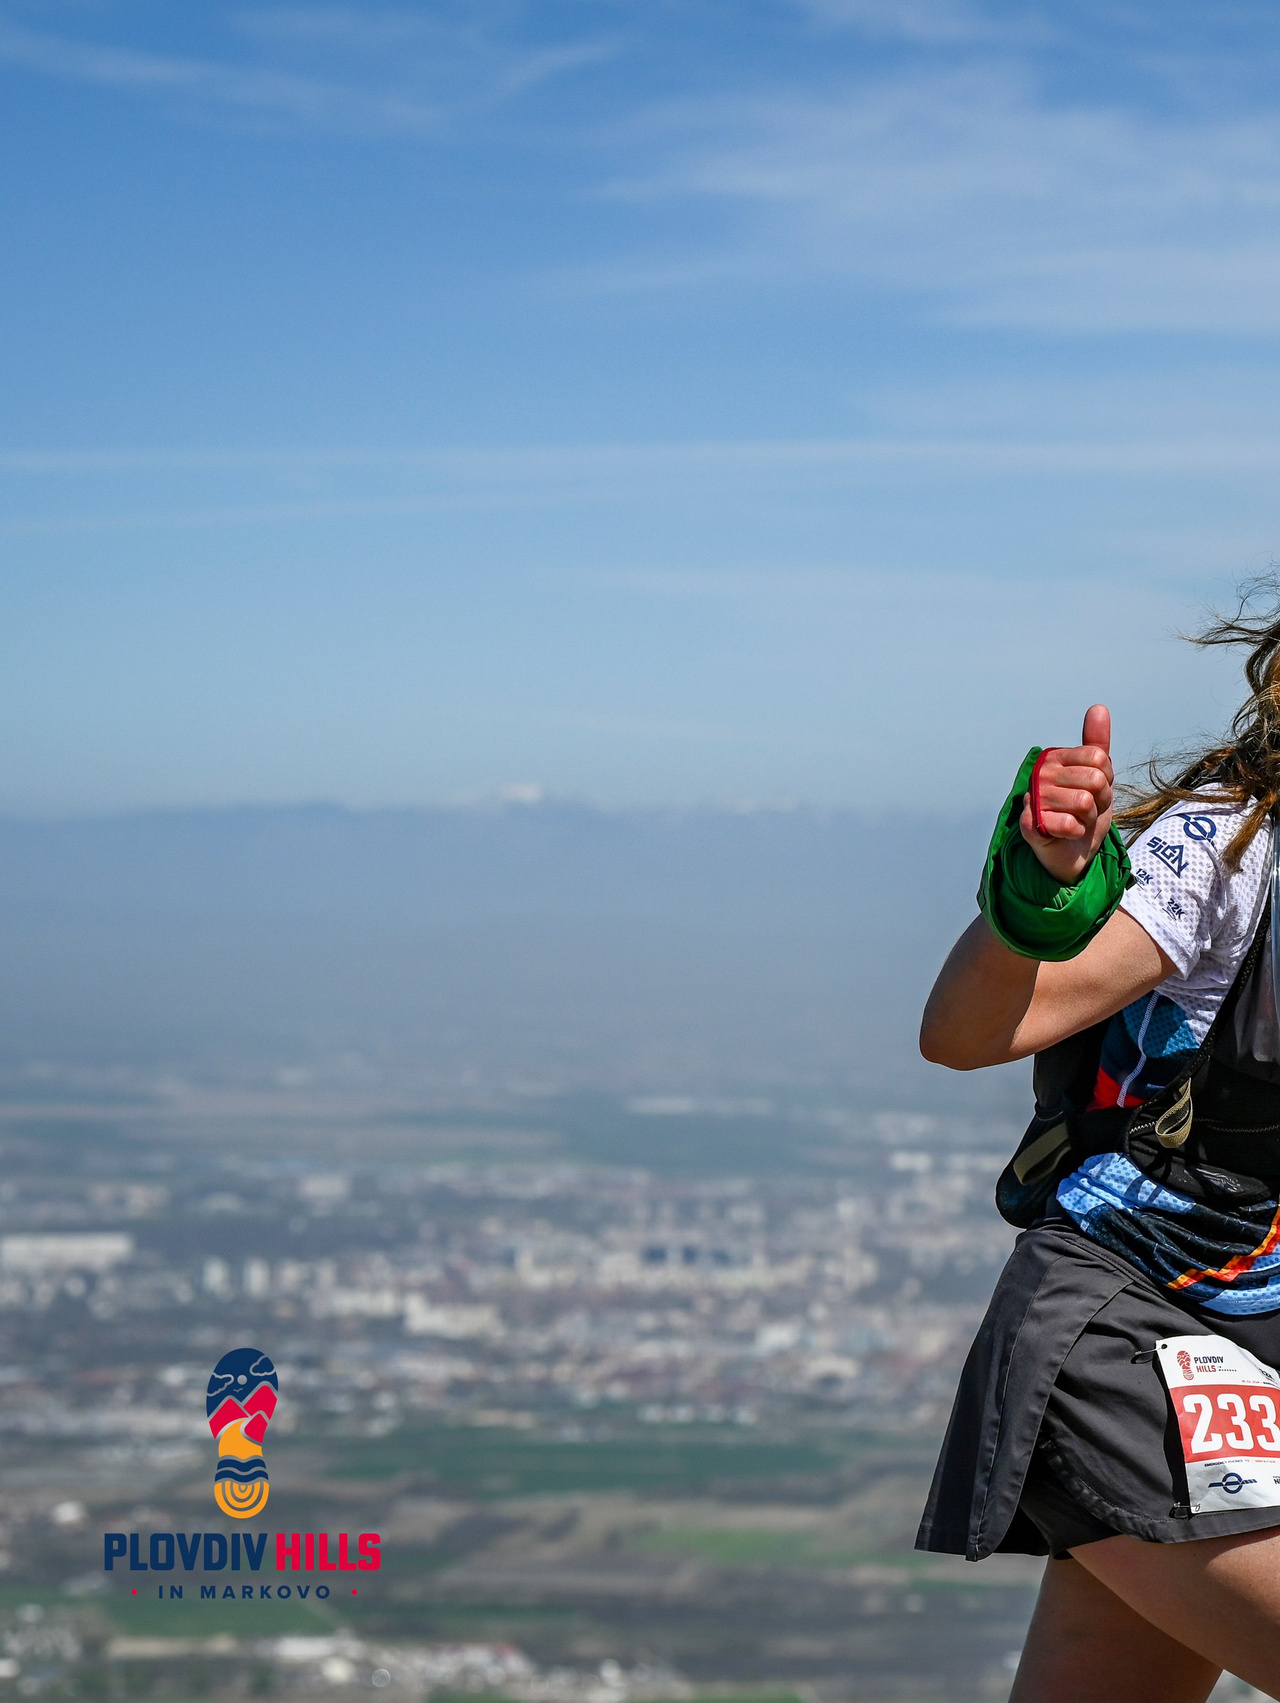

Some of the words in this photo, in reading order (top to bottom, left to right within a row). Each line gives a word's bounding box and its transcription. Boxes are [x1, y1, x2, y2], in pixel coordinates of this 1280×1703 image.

[1135, 868, 1154, 885] 12K
[1167, 897, 1185, 920] 22K
[1193, 1356, 1224, 1364] PLOVDIV
[1196, 1365, 1217, 1373] HILLS
